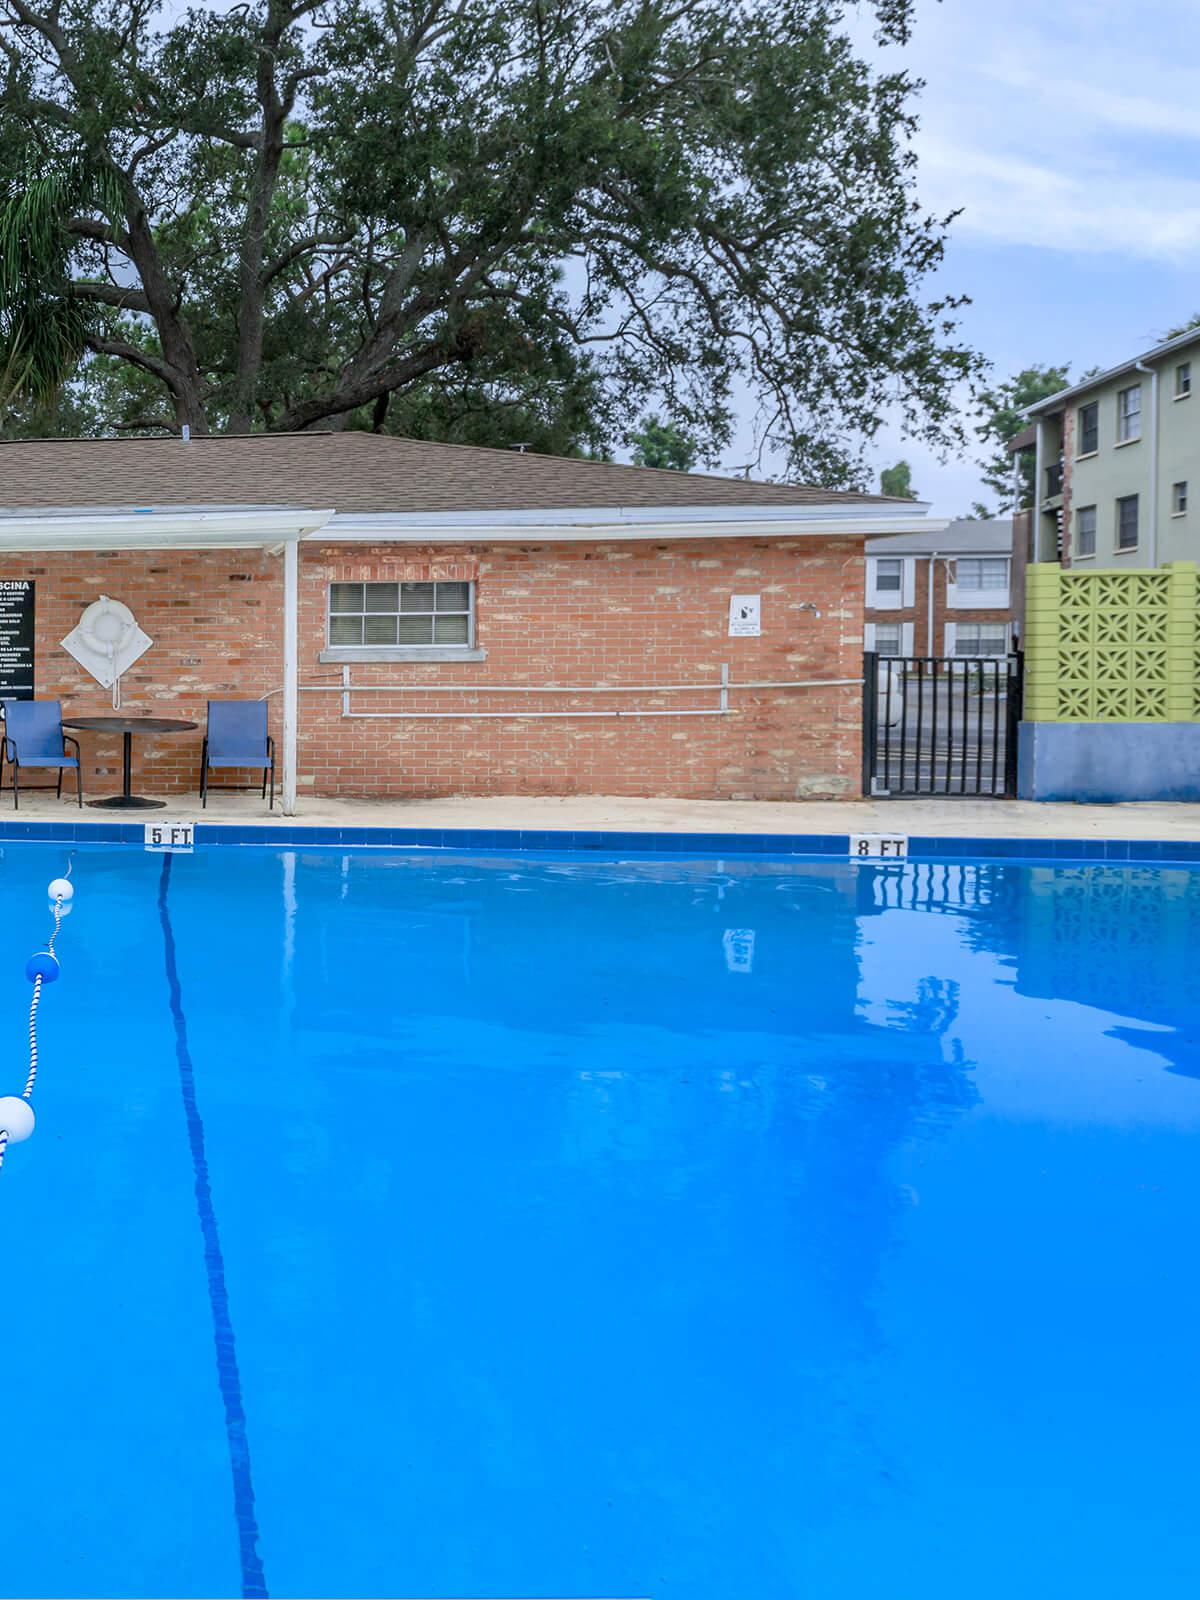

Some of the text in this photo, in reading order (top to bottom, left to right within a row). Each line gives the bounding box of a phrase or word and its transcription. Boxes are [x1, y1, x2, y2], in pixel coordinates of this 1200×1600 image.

[152, 828, 191, 844] 5 FT.
[858, 840, 904, 856] 8 FT
